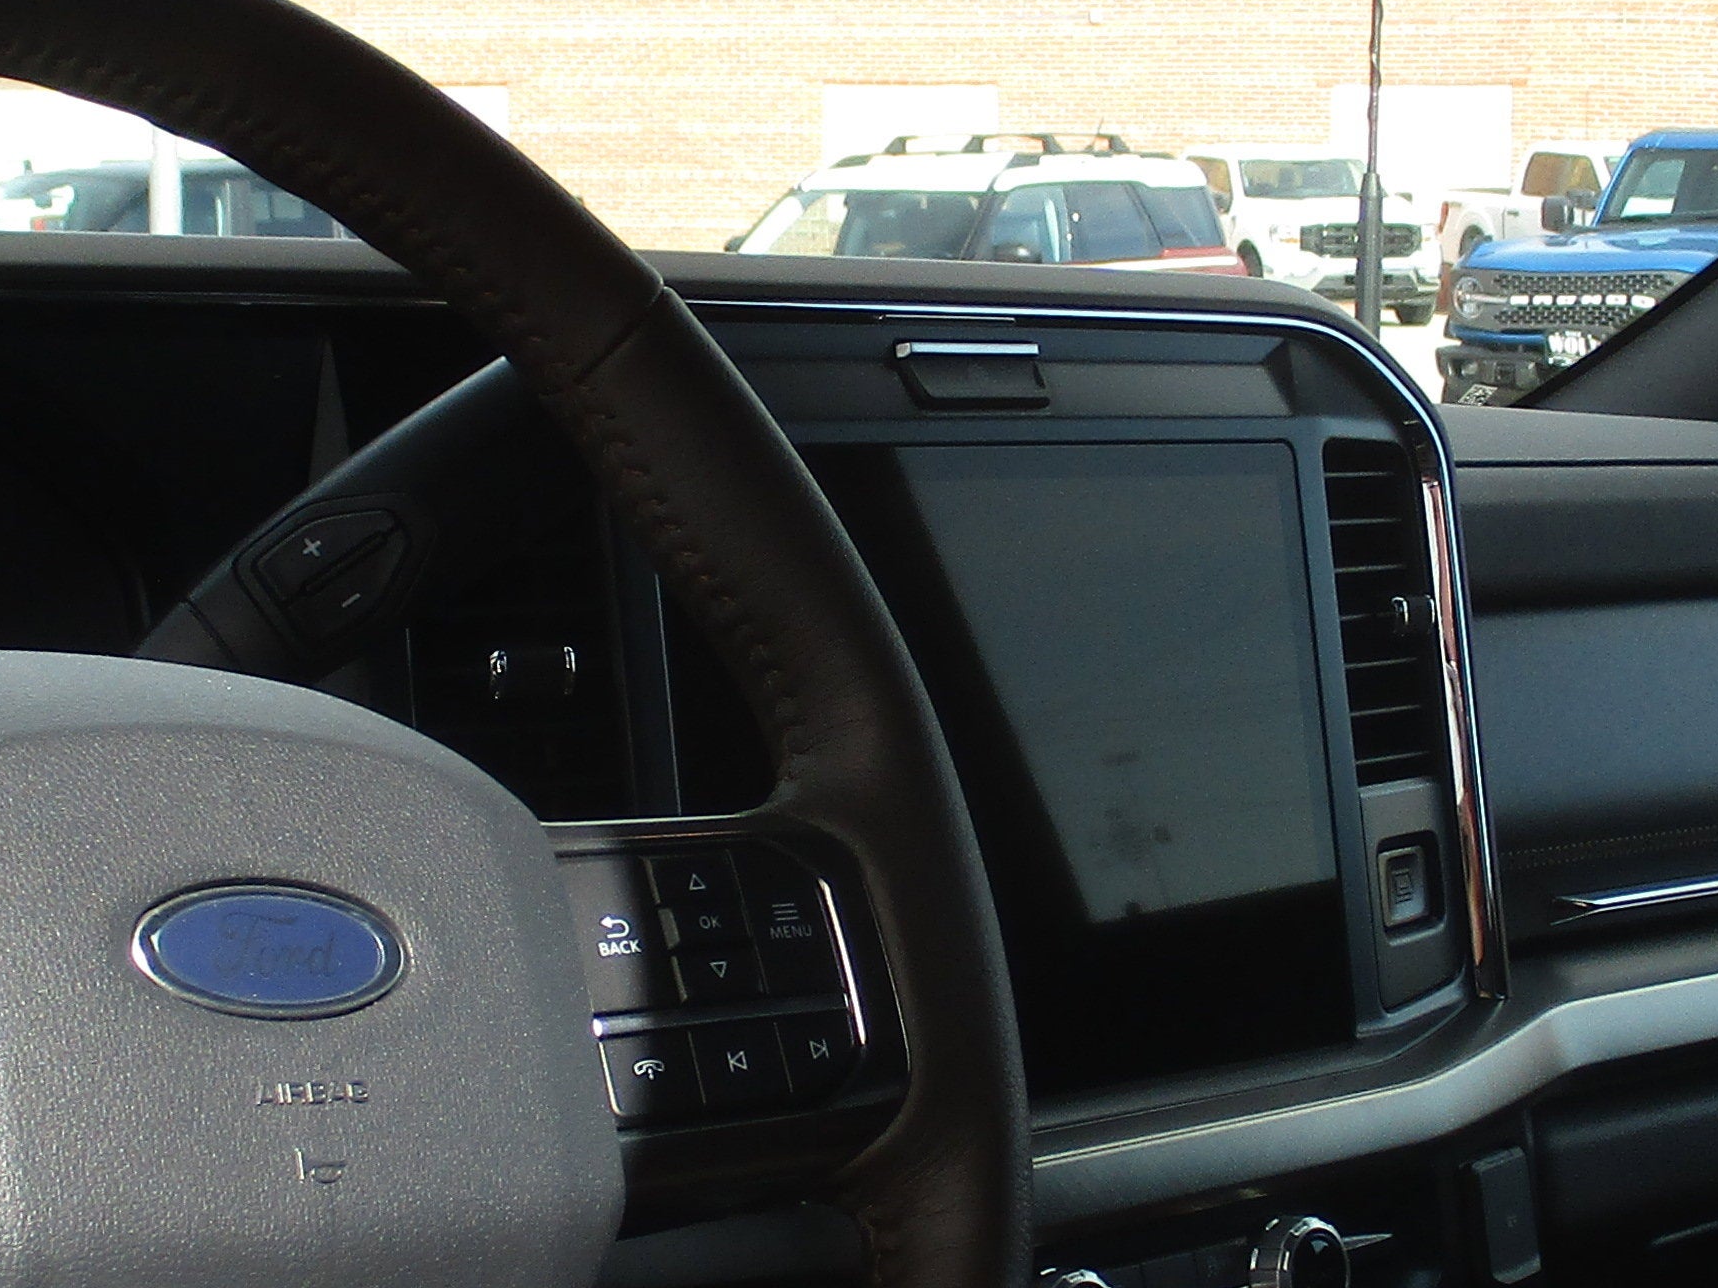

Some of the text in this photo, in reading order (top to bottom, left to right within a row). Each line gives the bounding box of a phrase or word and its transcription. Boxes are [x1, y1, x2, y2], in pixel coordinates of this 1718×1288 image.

[698, 914, 722, 930] OK
[770, 924, 812, 940] MENU
[215, 912, 336, 978] Ford
[598, 939, 643, 958] BACK
[255, 1081, 369, 1106] AIRBAG
